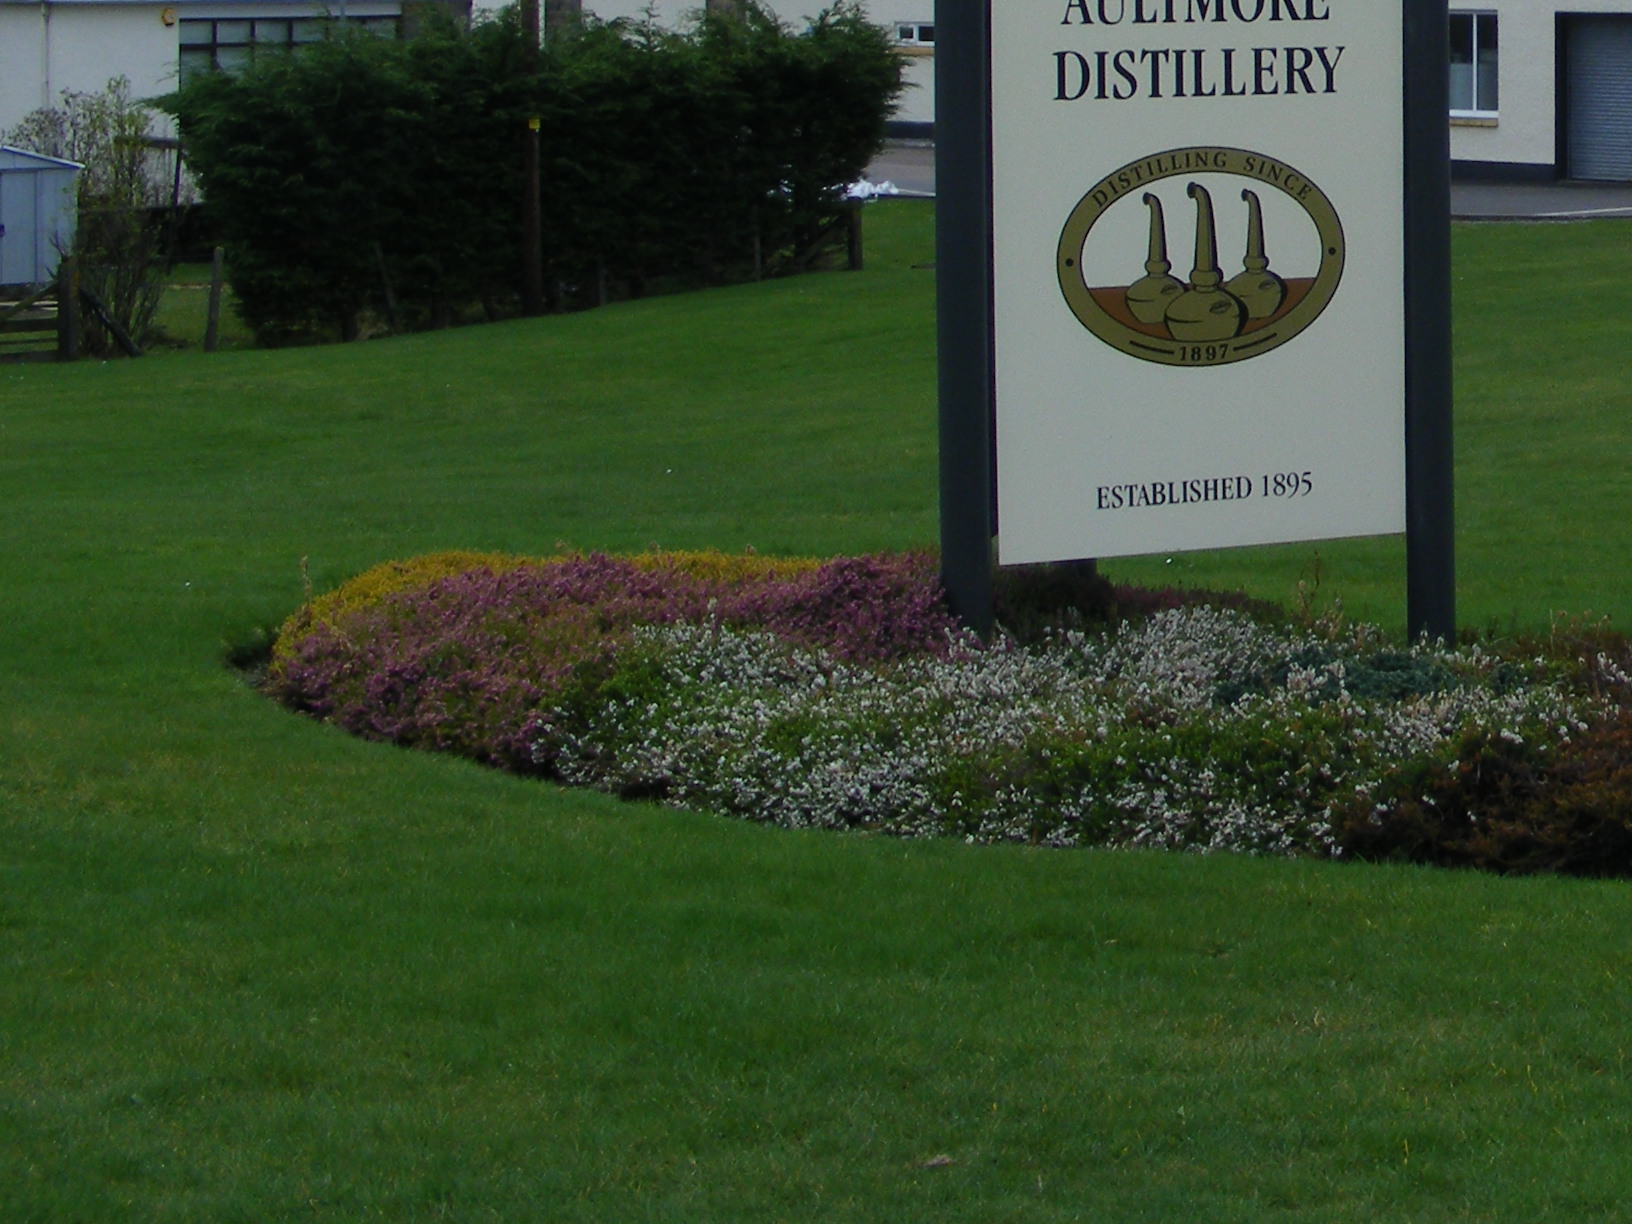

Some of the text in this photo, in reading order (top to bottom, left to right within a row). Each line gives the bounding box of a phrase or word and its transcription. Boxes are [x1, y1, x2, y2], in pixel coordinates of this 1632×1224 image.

[1053, 46, 1345, 101] DISTILLERY
[1092, 152, 1313, 207] DISTILLING SINCE
[1179, 344, 1228, 361] 1897
[1096, 471, 1313, 509] ESTABLISHED 1895
